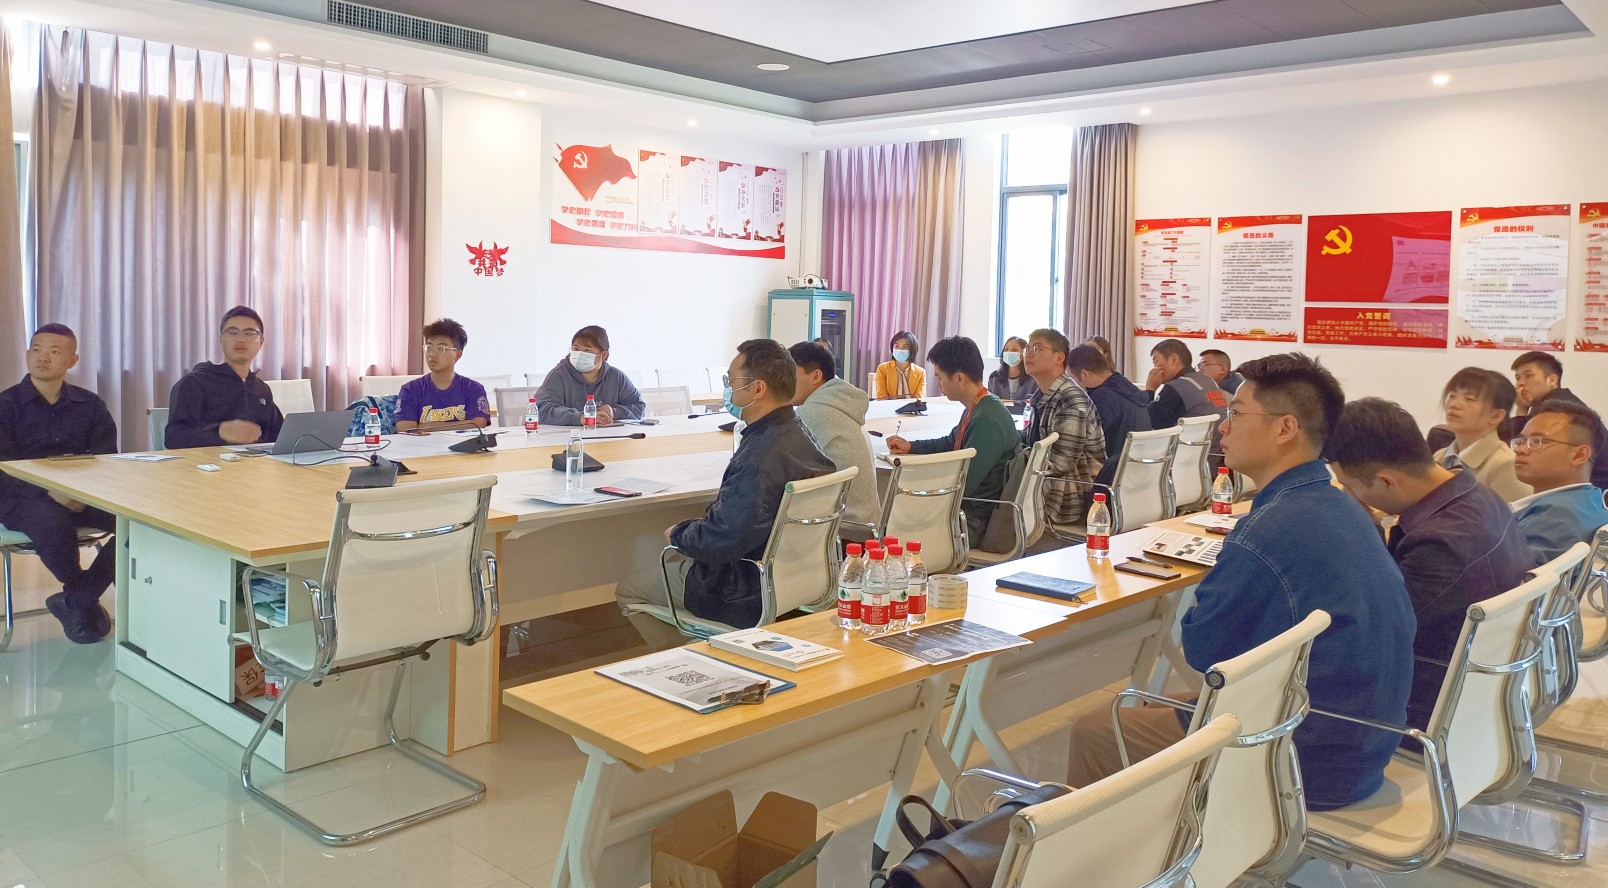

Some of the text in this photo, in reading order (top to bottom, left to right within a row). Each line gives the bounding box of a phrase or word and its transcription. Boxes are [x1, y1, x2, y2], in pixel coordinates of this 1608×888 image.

[1493, 225, 1534, 233] 党员的权利
[420, 404, 467, 423] LAKERS
